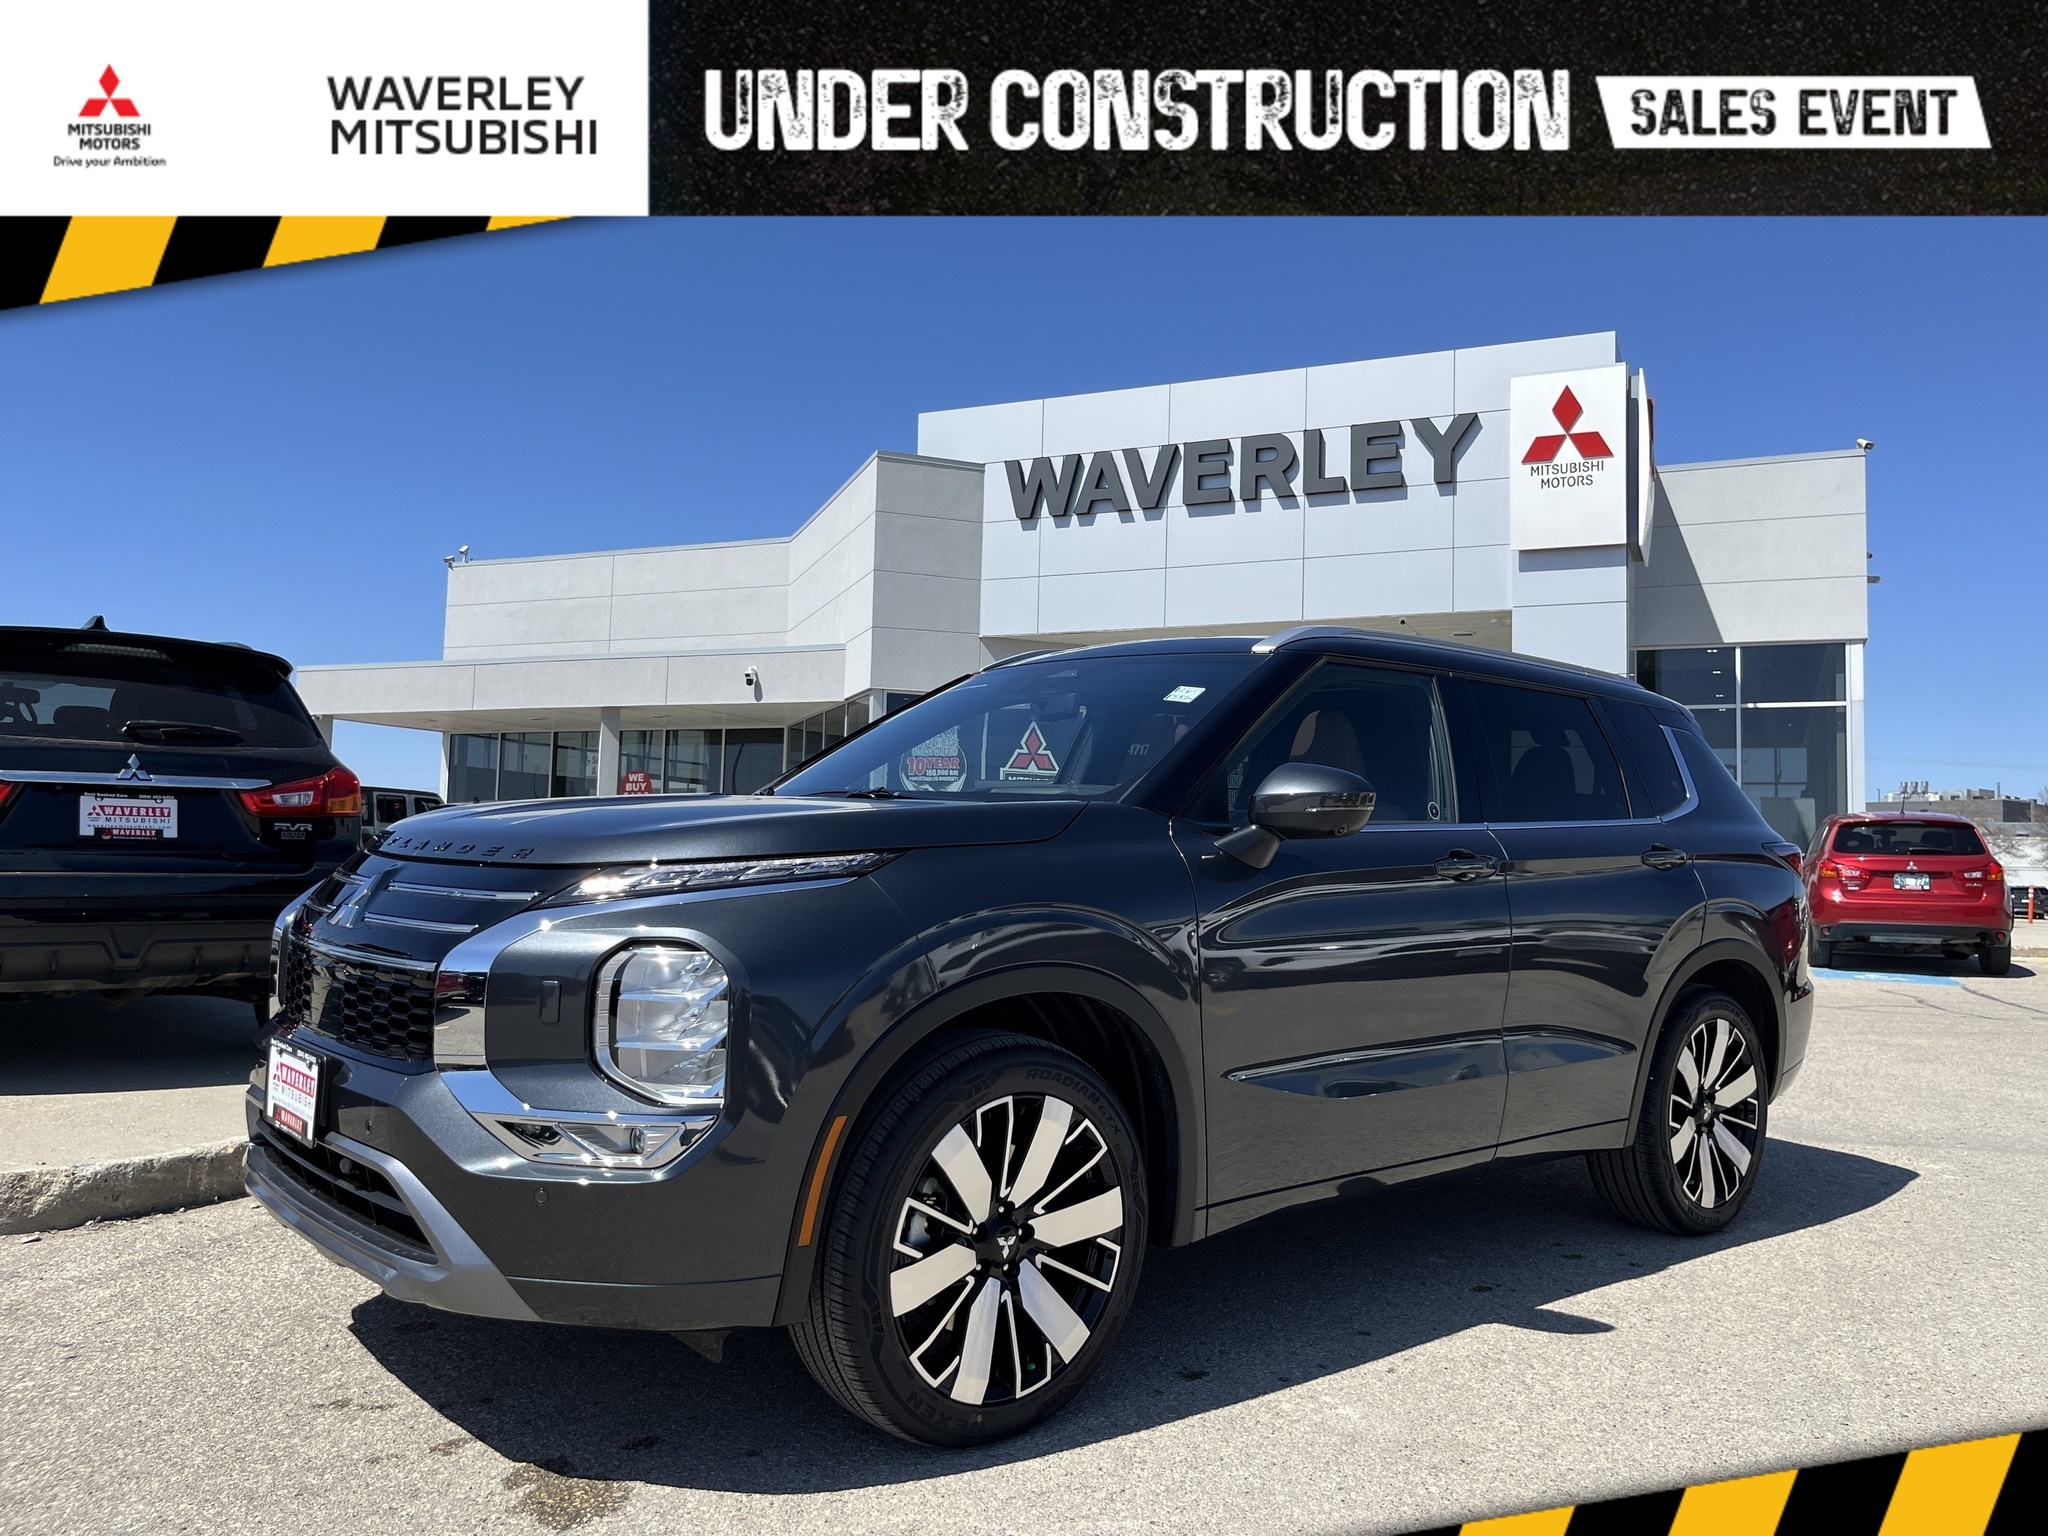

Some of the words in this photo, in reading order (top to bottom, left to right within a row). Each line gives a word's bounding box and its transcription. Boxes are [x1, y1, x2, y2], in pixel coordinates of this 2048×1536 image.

[1004, 412, 1482, 520] WAVERLEY
[1530, 460, 1605, 477] MITSUBISHI
[1540, 474, 1594, 489] MOTORS
[907, 757, 926, 775] 10
[925, 757, 960, 769] YEAR
[628, 773, 645, 782] WE
[625, 782, 647, 791] BUY
[103, 806, 170, 817] WAVERLEY
[105, 816, 171, 824] MITSUBISHI
[274, 822, 313, 831] RVR
[112, 828, 157, 836] WAVERLEY
[281, 1064, 315, 1097] WAVERLEY
[281, 1084, 313, 1110] MITSUBISHI
[1025, 1067, 1101, 1105] ROADIAN
[1097, 1105, 1122, 1136] GTX
[905, 1390, 986, 1434] NEXEN
